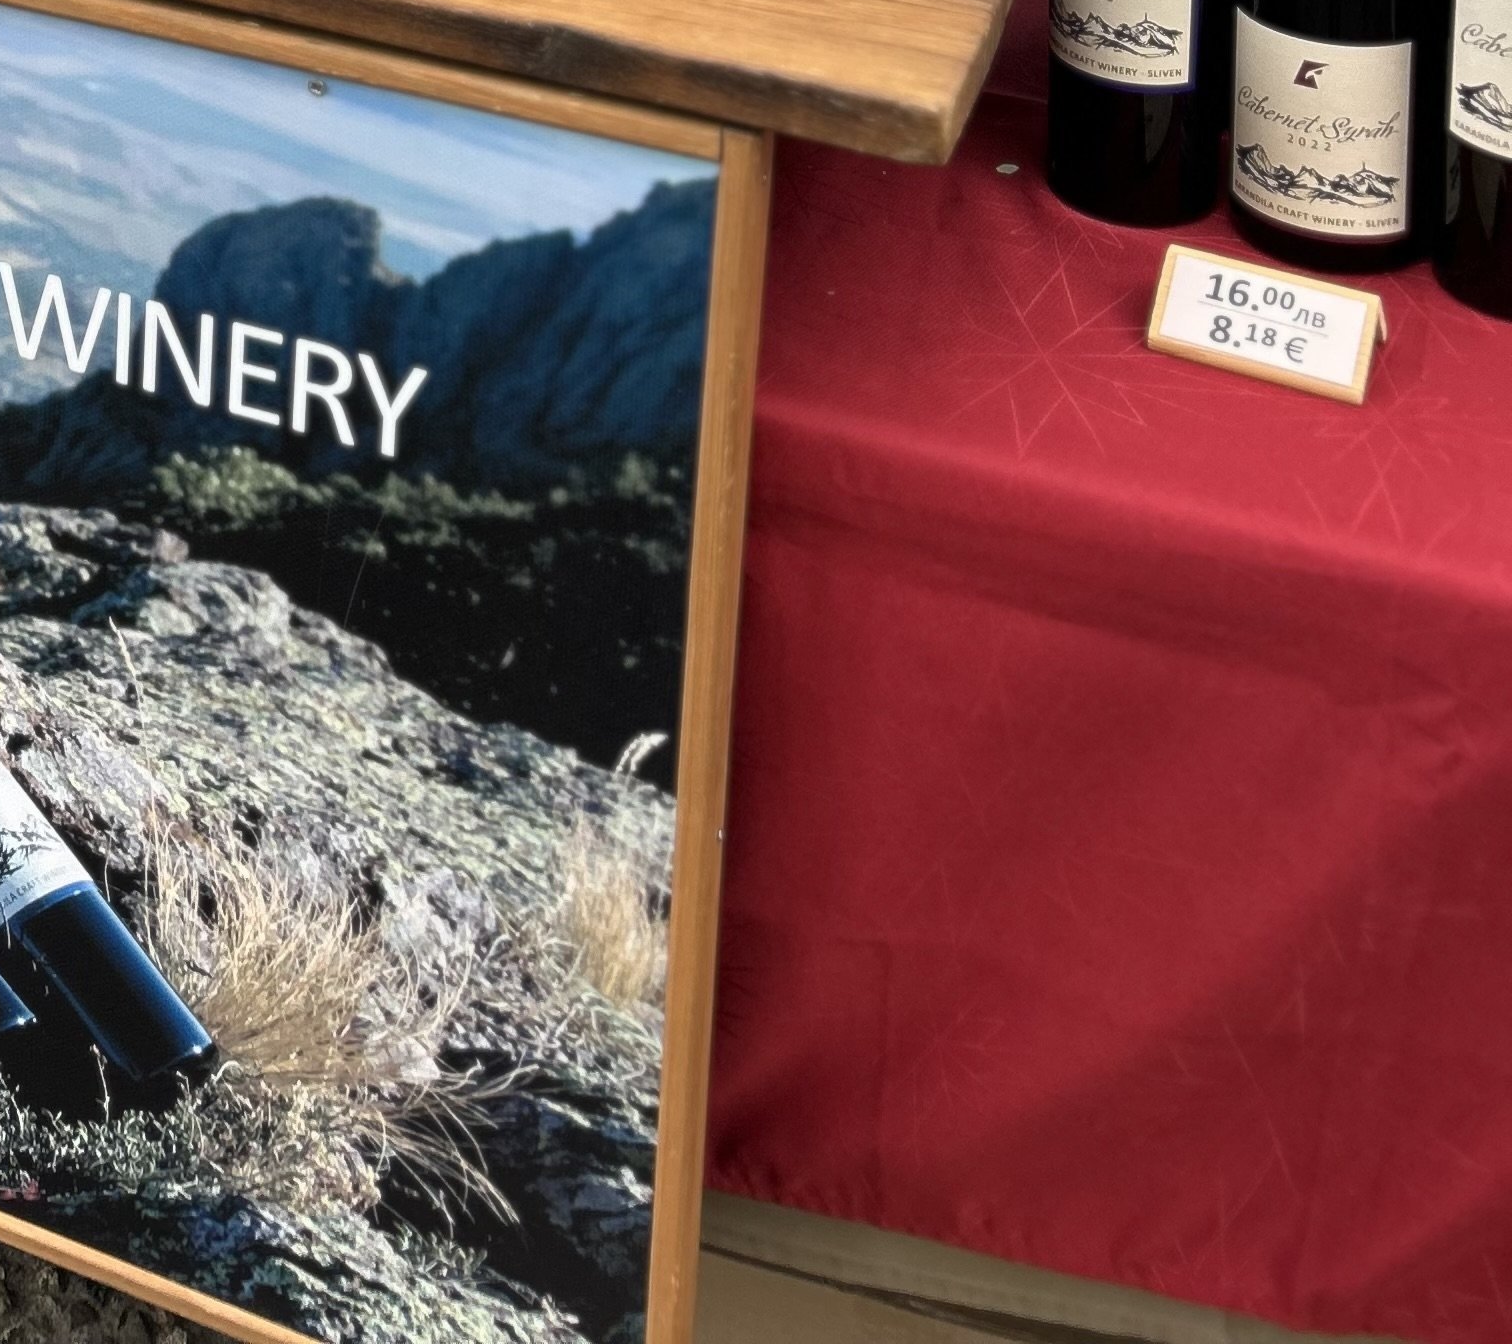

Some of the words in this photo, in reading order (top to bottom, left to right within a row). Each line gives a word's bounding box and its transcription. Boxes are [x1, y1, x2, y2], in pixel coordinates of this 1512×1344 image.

[1070, 50, 1095, 67] CRAFT
[1097, 60, 1138, 76] WINERY
[1147, 68, 1182, 78] SLIVEN
[1238, 85, 1321, 134] Cabernet
[1288, 134, 1332, 152] 2022
[1276, 204, 1309, 221] CRAFT
[1311, 214, 1356, 228] WINERY
[1365, 217, 1400, 229] SLIVEN
